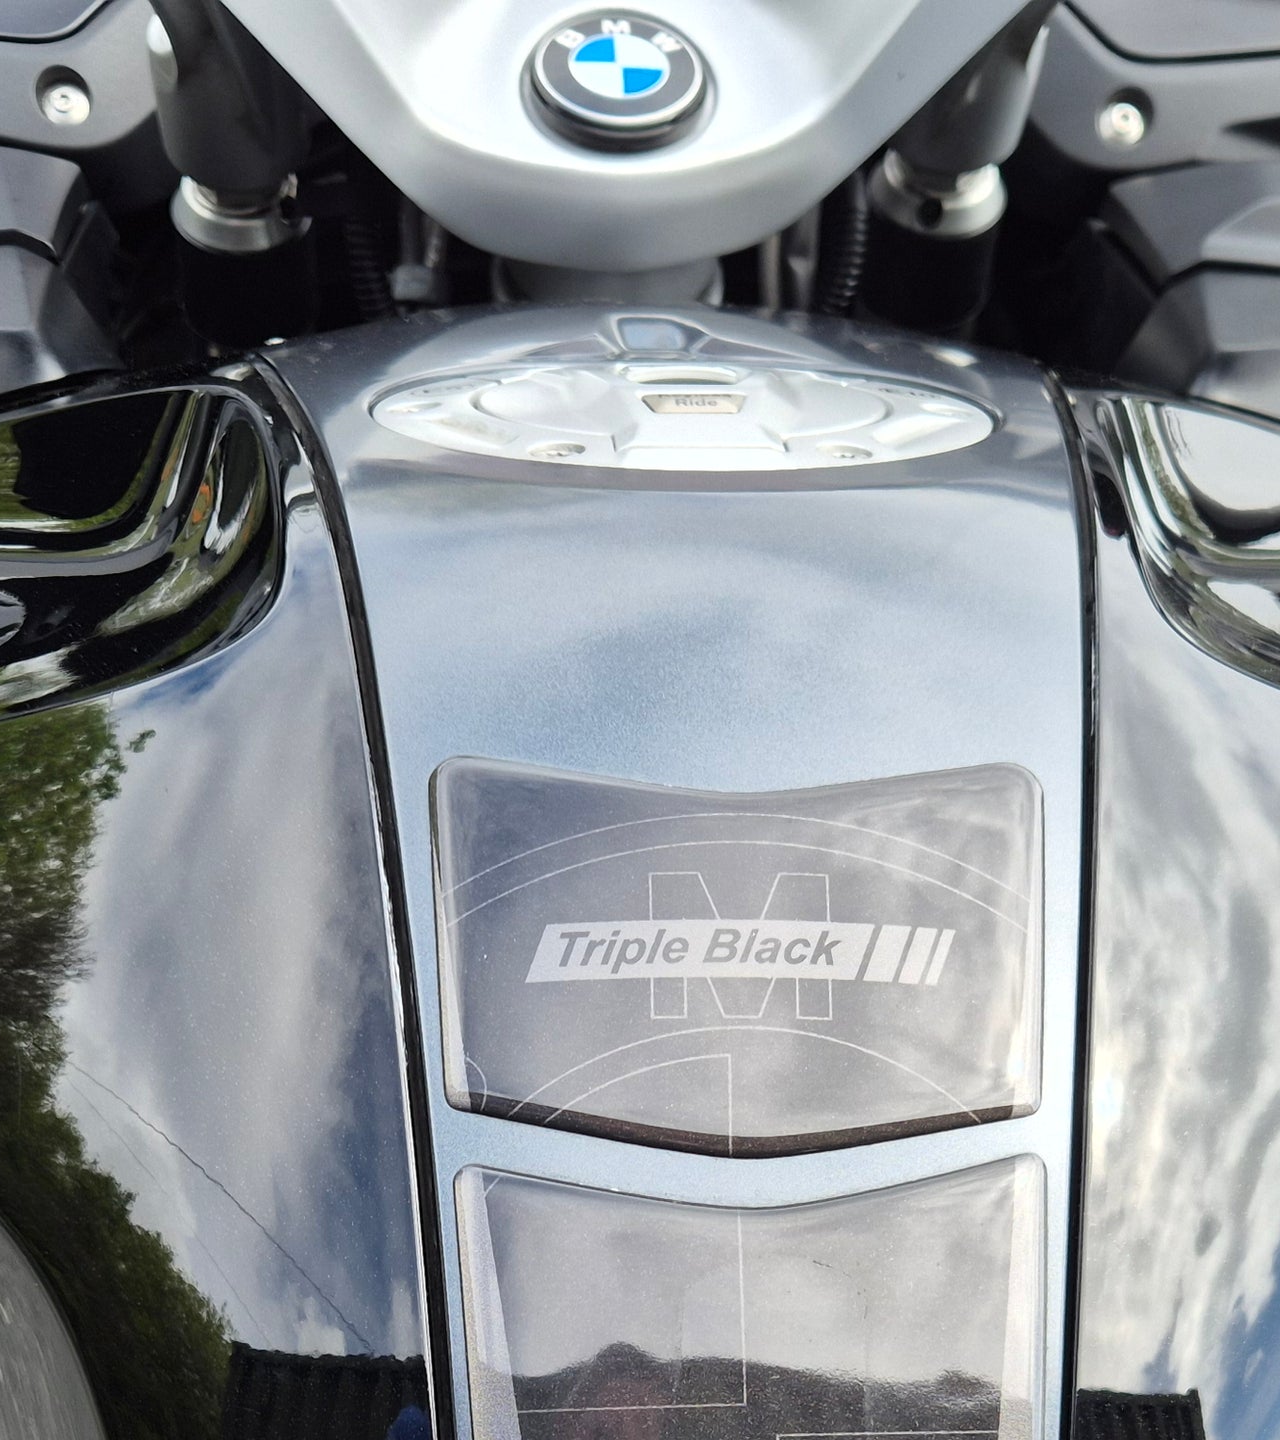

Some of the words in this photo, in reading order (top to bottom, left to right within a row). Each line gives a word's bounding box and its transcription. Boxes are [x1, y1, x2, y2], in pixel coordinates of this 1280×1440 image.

[554, 18, 684, 52] BMW
[674, 397, 719, 407] Ride
[558, 929, 690, 974] Triple
[703, 927, 841, 966] Black
